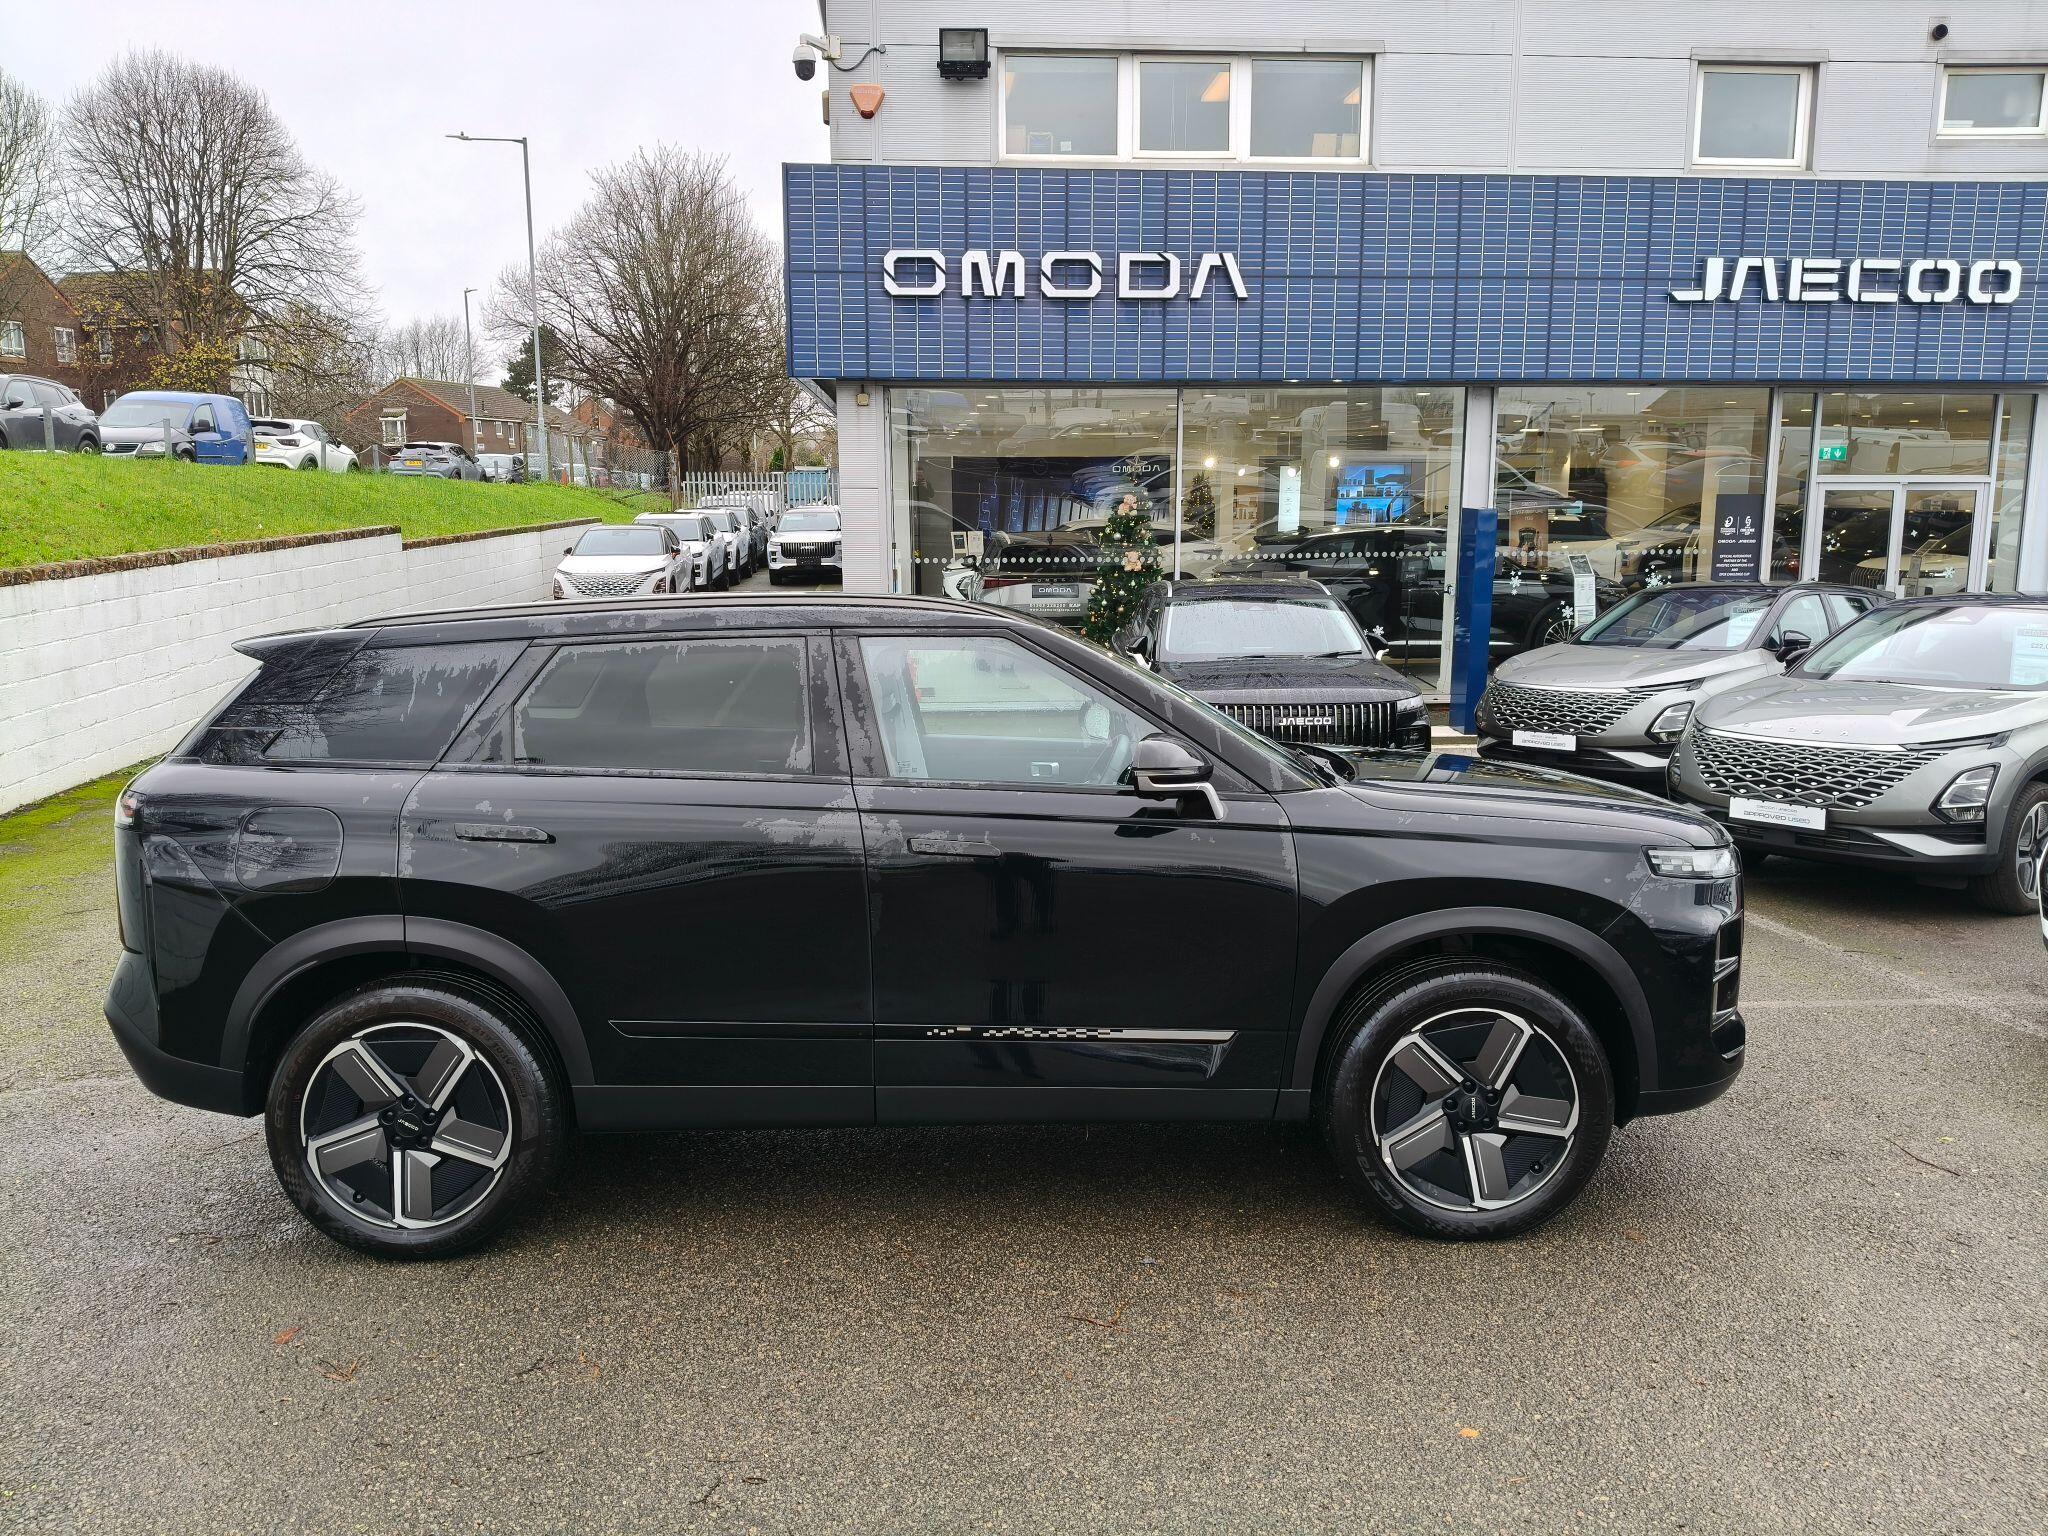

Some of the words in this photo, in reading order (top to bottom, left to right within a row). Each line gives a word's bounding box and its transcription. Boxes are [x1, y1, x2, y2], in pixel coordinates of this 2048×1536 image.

[884, 249, 1249, 299] OMODA
[1670, 257, 2023, 304] JAECOO
[1112, 465, 1161, 473] OMODA
[1279, 717, 1332, 726] JAECOO
[397, 1118, 419, 1131] JAECOO
